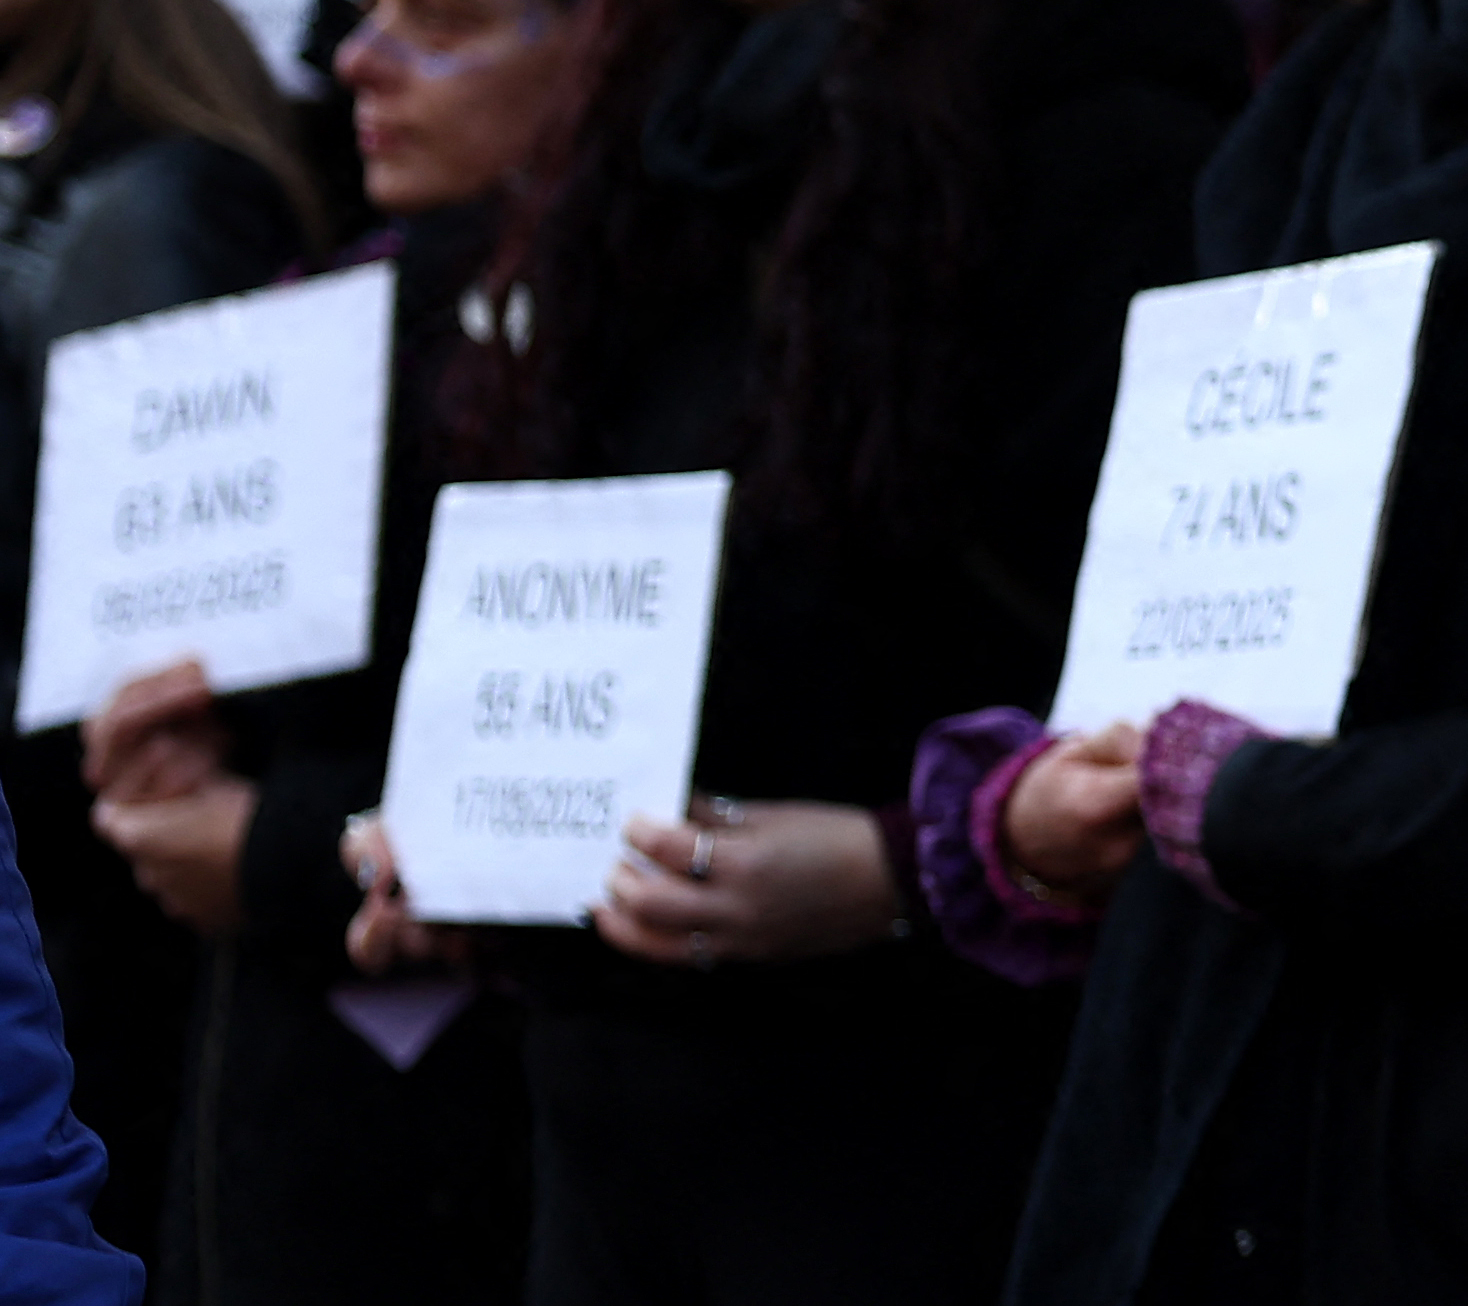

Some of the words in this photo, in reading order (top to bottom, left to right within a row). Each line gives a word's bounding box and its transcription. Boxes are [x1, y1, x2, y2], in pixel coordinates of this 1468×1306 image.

[1186, 347, 1338, 438] CÉCILE
[177, 459, 281, 535] ANS
[1207, 471, 1304, 545] ANS
[461, 558, 668, 629] ANONYME
[526, 669, 622, 739] ANS
